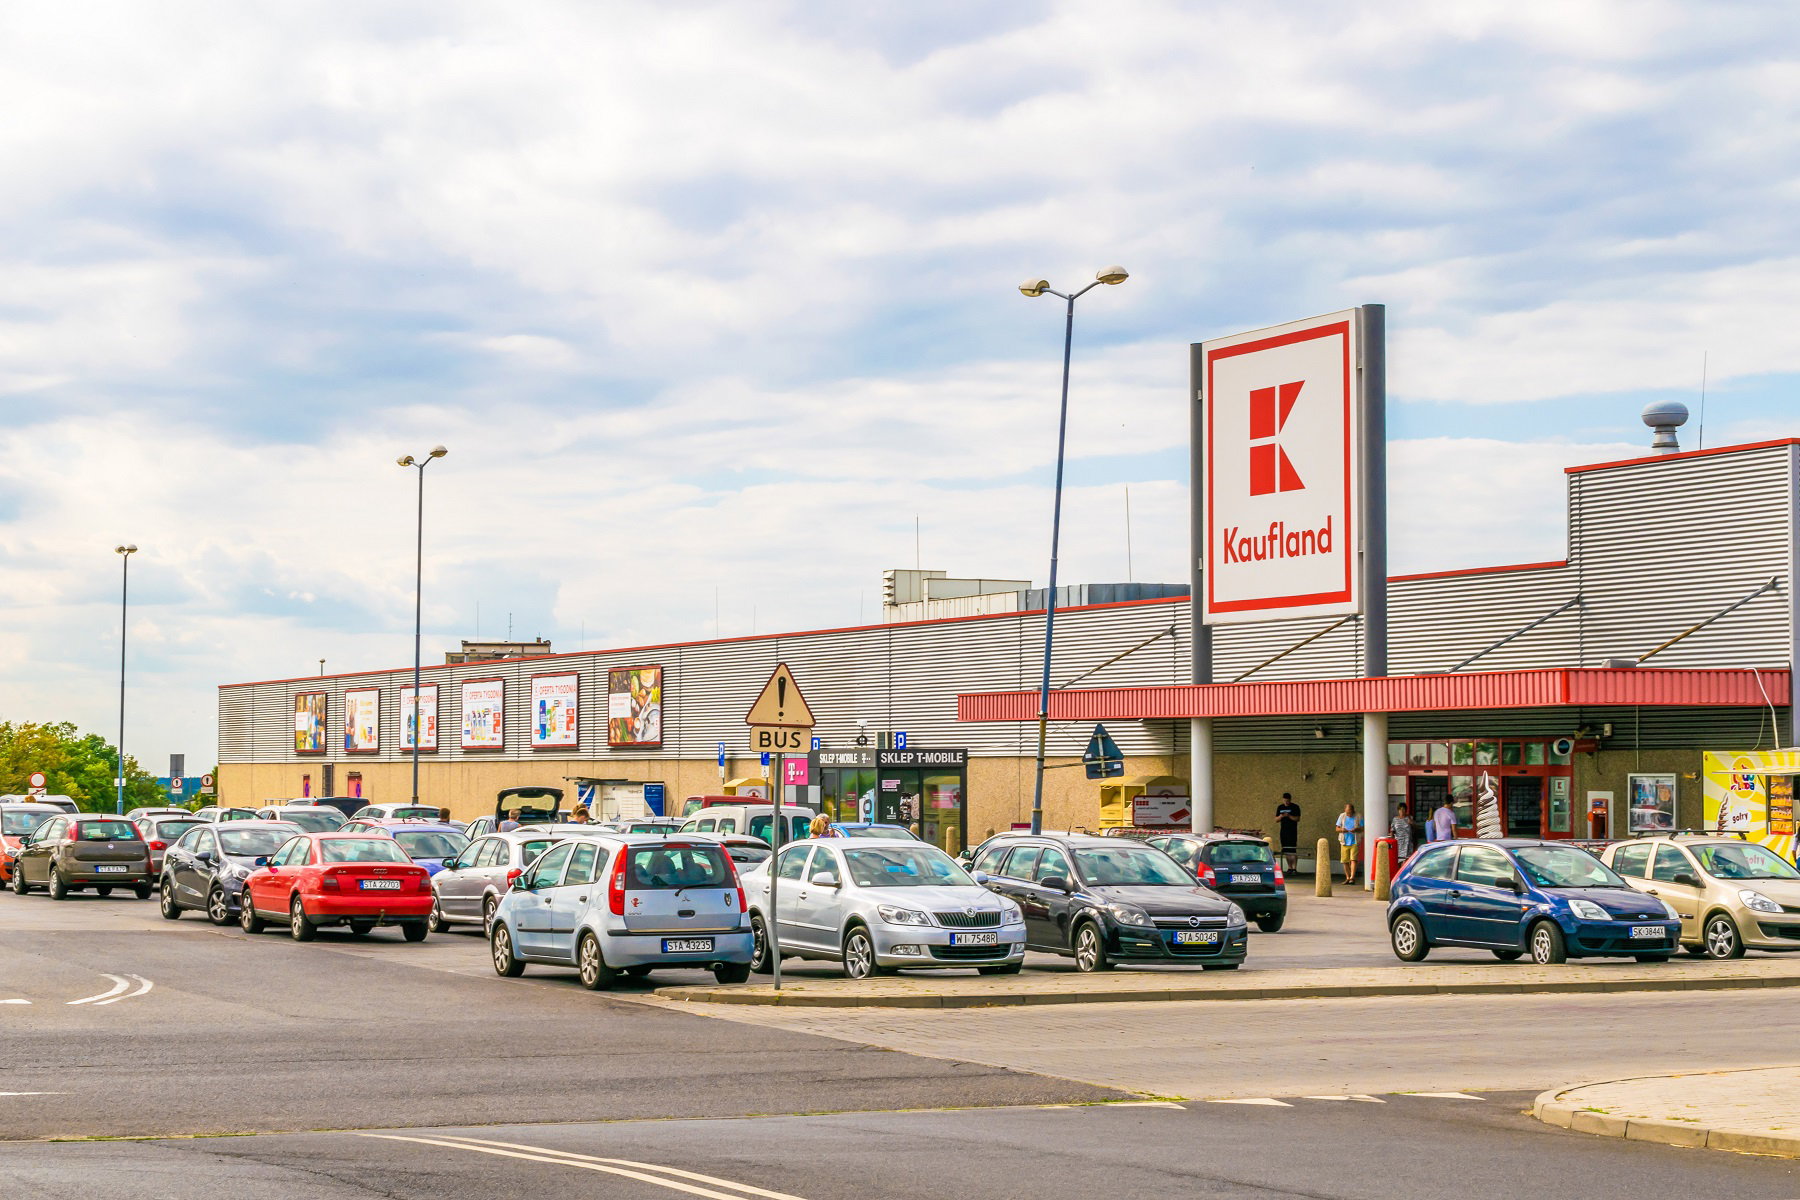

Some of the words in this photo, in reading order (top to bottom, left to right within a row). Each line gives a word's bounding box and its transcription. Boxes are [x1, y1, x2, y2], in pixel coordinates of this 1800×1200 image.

[1250, 380, 1305, 496] K
[1224, 515, 1332, 564] Kaufland
[759, 731, 801, 748] BUS
[898, 734, 905, 748] P
[819, 753, 835, 764] SKLEP
[836, 753, 858, 764] T-MOBILE
[880, 752, 914, 764] SKLEP
[916, 752, 963, 764] T-MOBILE
[364, 880, 377, 889] STA
[379, 880, 400, 889] 22703
[1178, 932, 1193, 942] STA
[1195, 932, 1217, 942] 50345
[1633, 927, 1643, 936] SK
[1645, 927, 1664, 936] 3844X
[956, 935, 967, 944] WI
[971, 934, 996, 944] 7548R
[667, 941, 684, 950] STA
[686, 940, 711, 950] 43235
